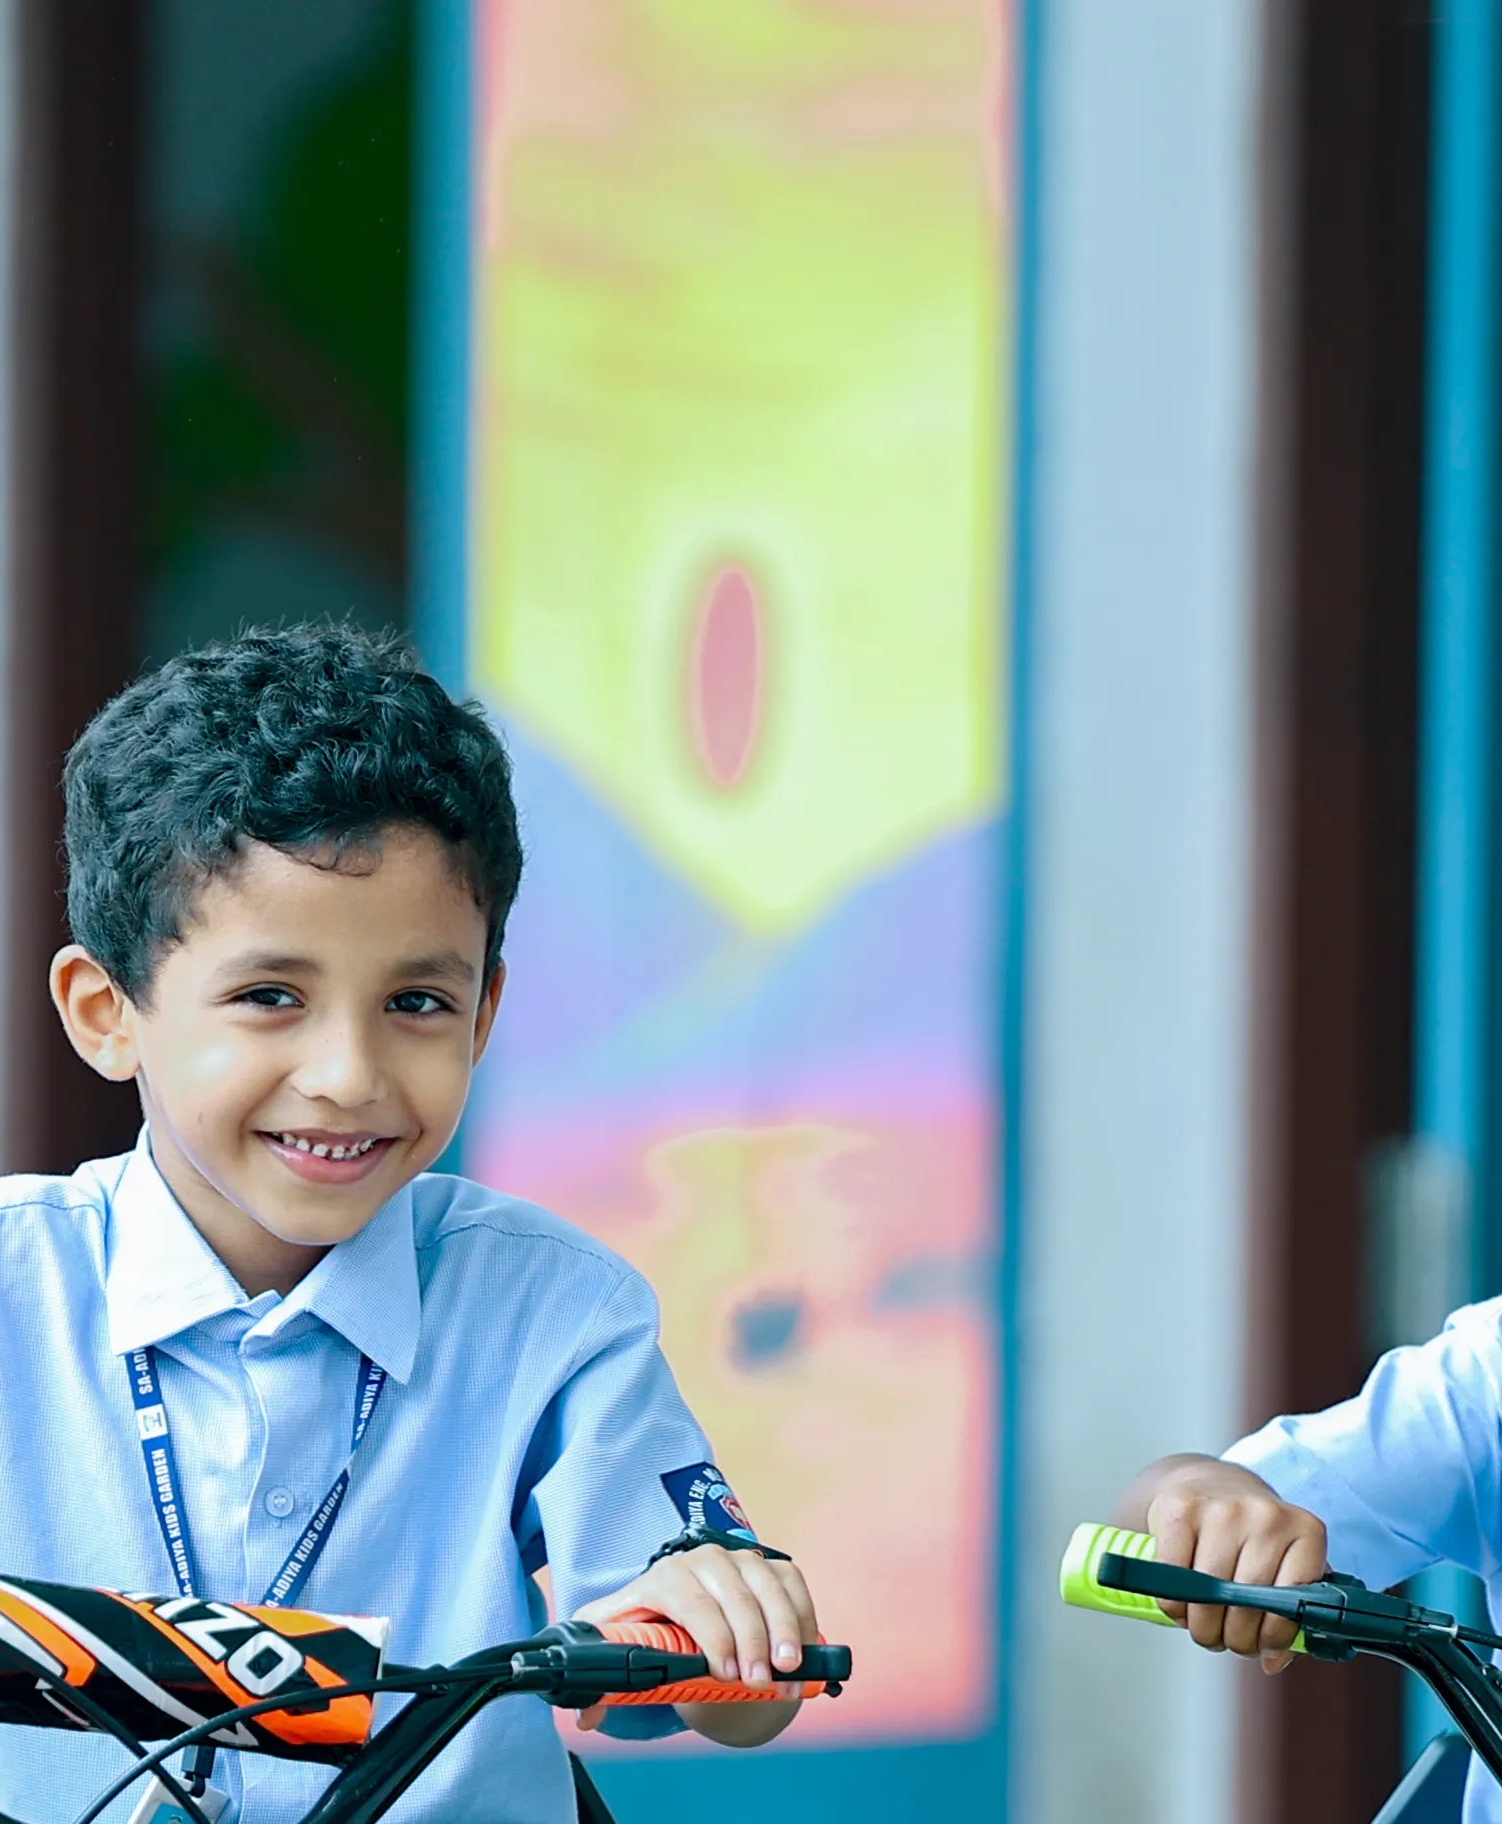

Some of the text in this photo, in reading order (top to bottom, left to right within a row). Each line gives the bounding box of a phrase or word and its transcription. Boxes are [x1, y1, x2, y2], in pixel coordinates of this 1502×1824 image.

[151, 1448, 174, 1503] GARDEN
[162, 1504, 182, 1539] KIDS
[265, 1483, 344, 1608] A-ADIYA KIDS GARDEN
